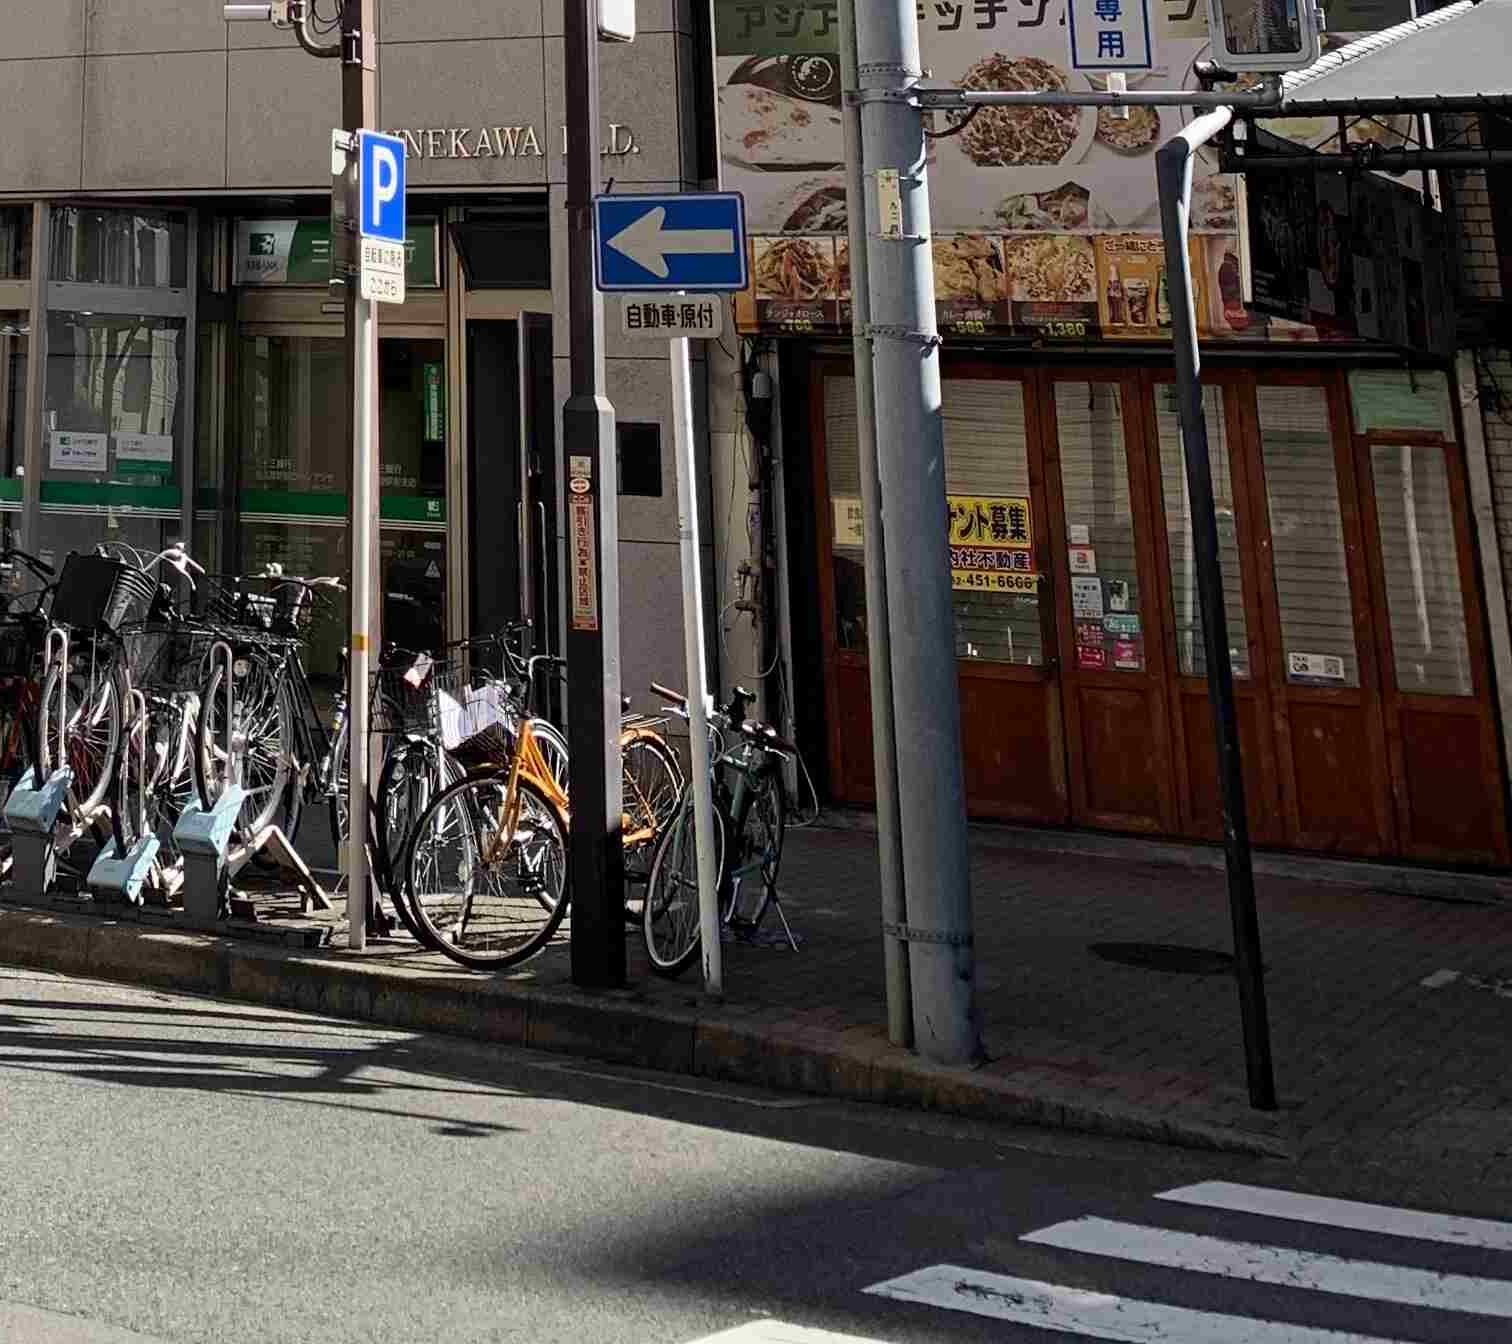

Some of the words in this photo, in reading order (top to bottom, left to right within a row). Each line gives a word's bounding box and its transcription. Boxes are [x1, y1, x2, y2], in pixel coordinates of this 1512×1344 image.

[372, 144, 398, 227] P
[627, 303, 714, 329] 自動車・原付
[947, 504, 1027, 541] ント募集
